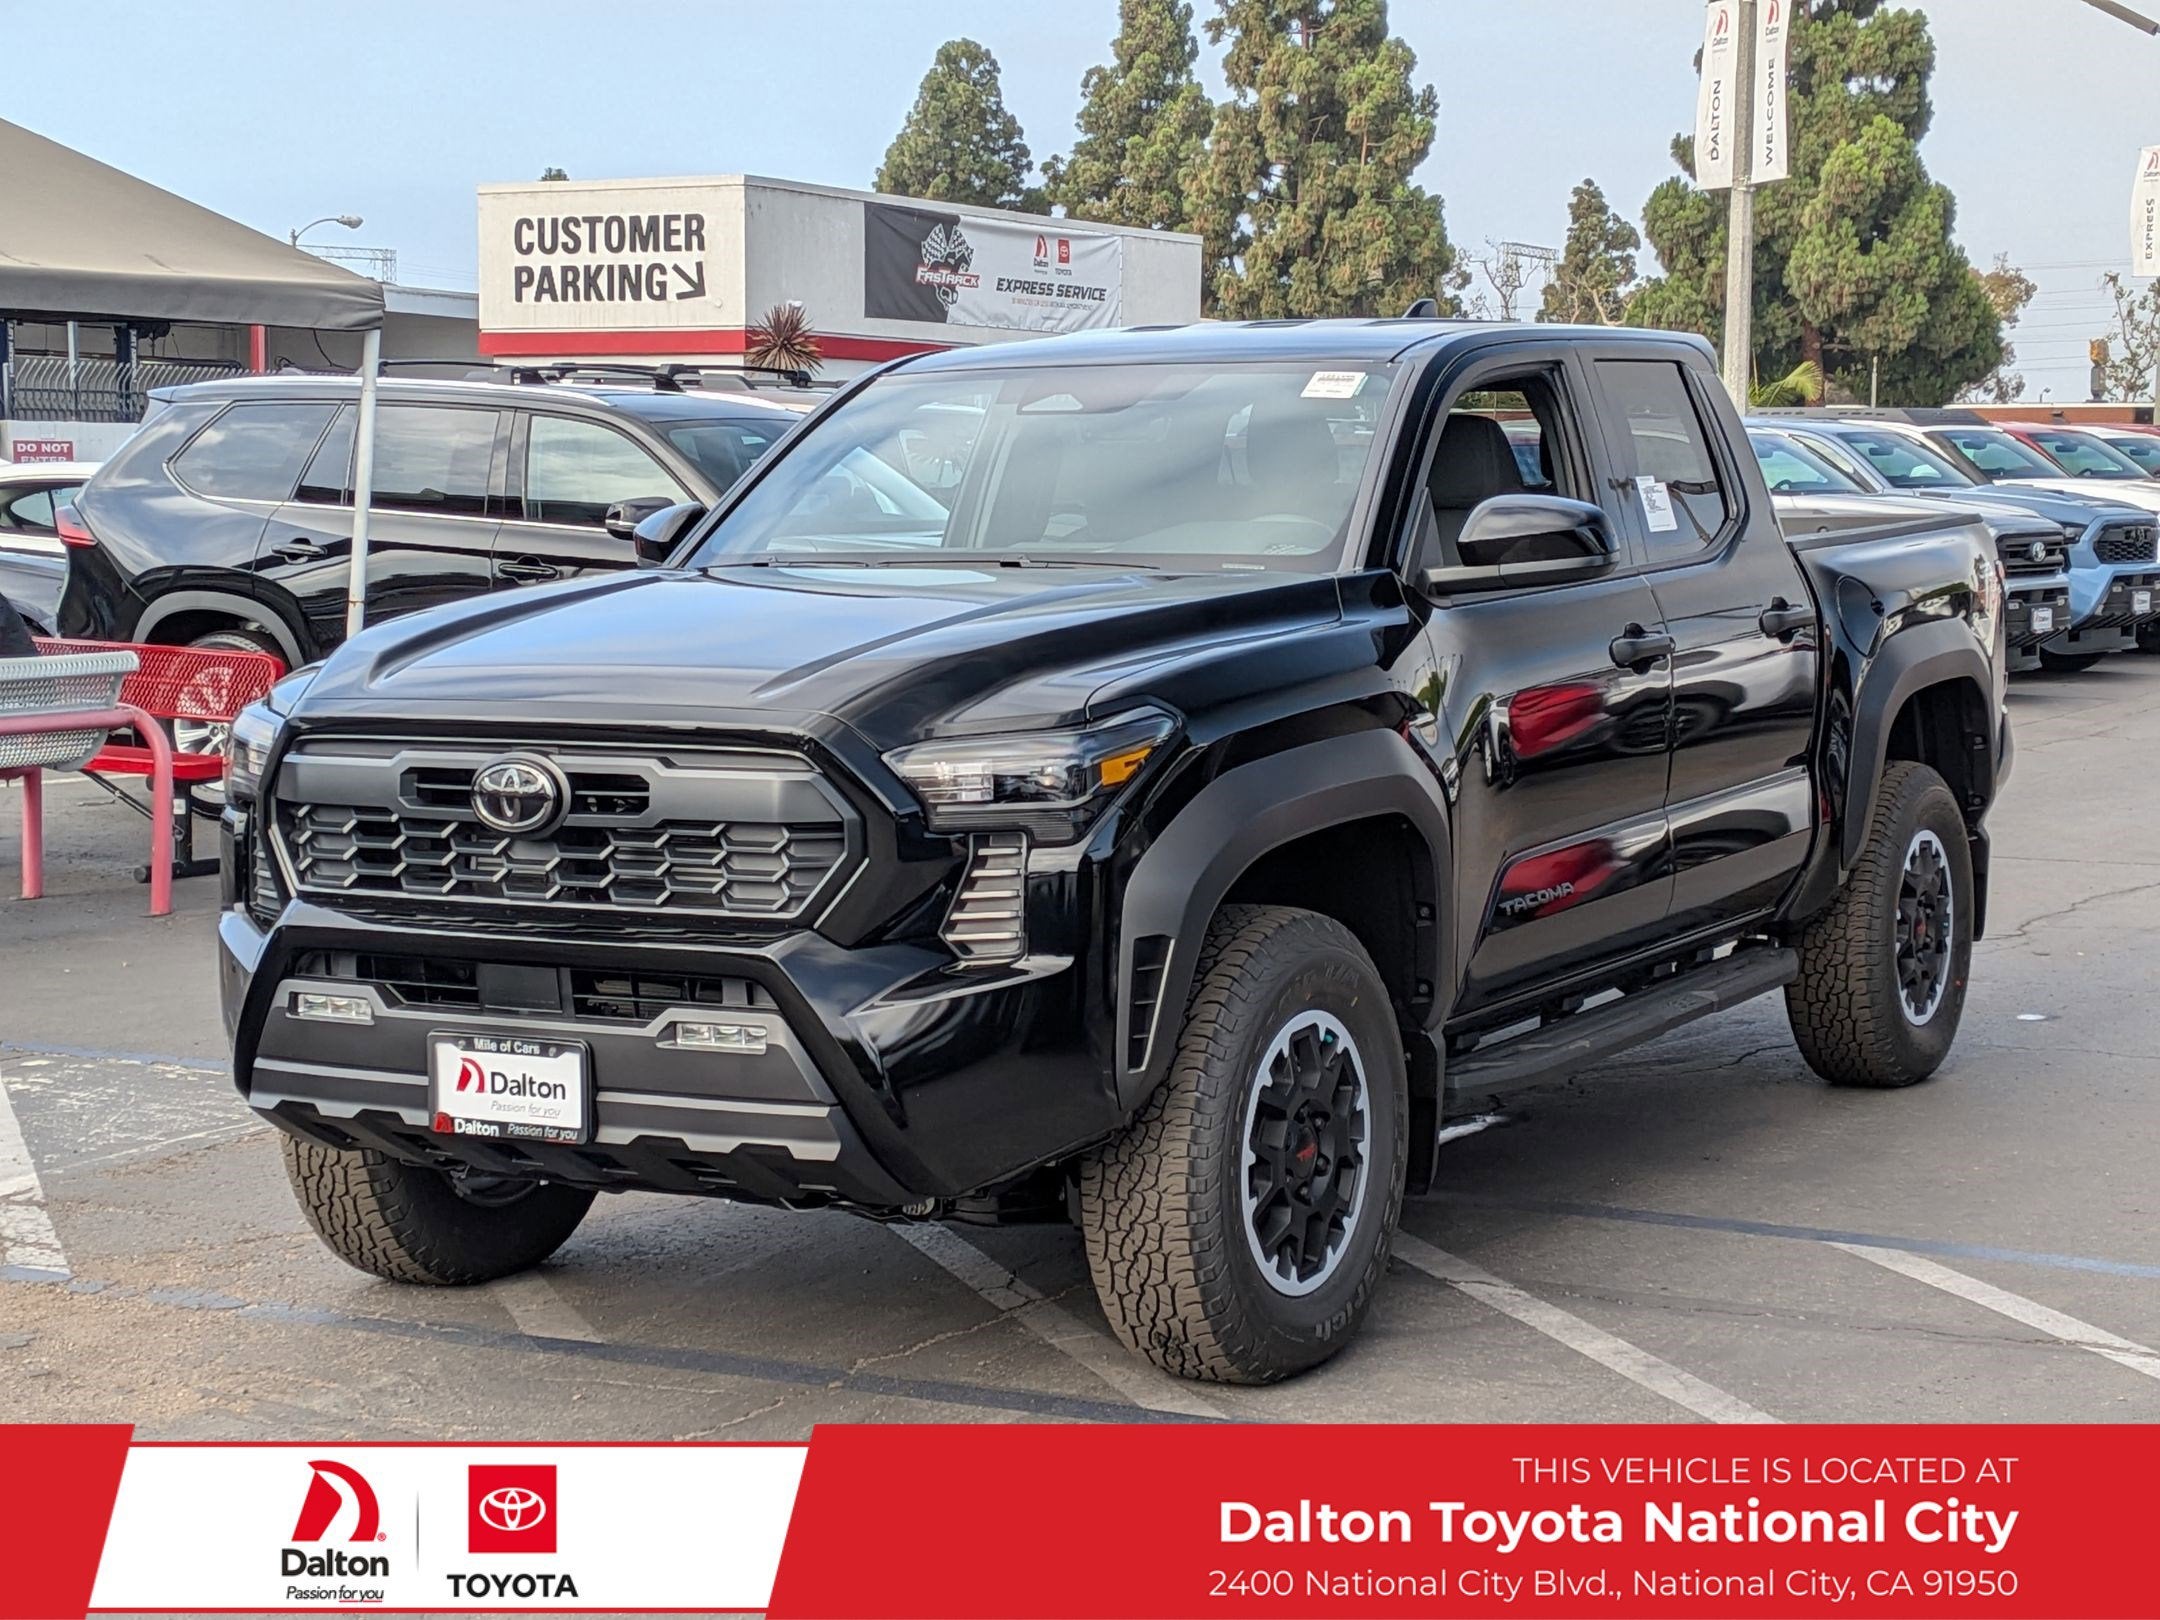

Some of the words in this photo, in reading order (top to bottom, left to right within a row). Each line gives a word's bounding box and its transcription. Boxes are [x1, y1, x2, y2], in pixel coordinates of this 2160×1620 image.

[1711, 80, 1722, 161] DALTON
[1765, 58, 1776, 167] WELCOME
[514, 214, 706, 256] CUSTOMER
[2145, 198, 2156, 260] EXPRESS
[514, 263, 668, 303] PARKING
[996, 277, 1054, 297] EXPRESS
[1056, 284, 1108, 302] SERVICE
[17, 443, 37, 453] DO
[41, 443, 70, 453] NOT
[1499, 882, 1575, 916] TACOMA
[474, 1038, 498, 1052] Mile
[500, 1042, 512, 1052] of
[513, 1042, 541, 1055] Cars
[490, 1071, 566, 1100] Dalton
[490, 1100, 526, 1114] Passion
[528, 1104, 542, 1115] for
[543, 1107, 562, 1118] you
[454, 1118, 500, 1137] Dalton
[507, 1123, 543, 1139] Passion
[544, 1126, 559, 1139] for
[559, 1127, 578, 1142] you
